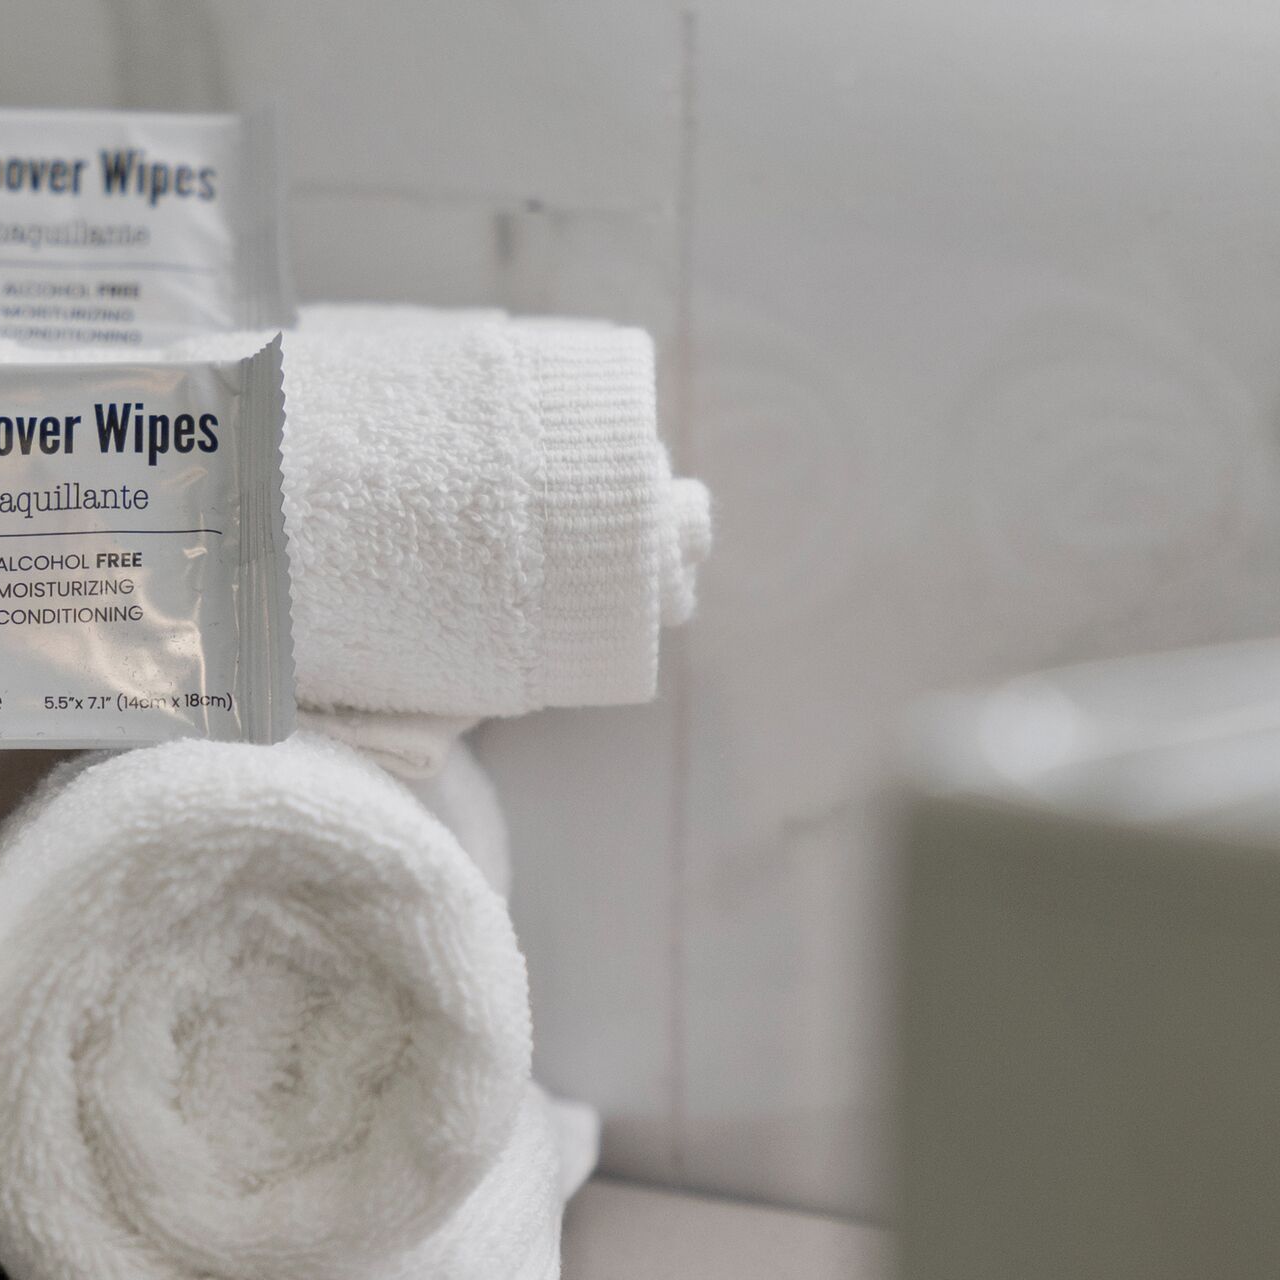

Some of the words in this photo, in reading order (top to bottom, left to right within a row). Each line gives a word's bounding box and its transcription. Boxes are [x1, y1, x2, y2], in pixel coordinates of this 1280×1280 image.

[99, 147, 217, 208] Wipes
[94, 402, 219, 466] Wipes
[96, 552, 143, 568] FREE
[116, 693, 167, 712] (14cm
[171, 697, 180, 708] x
[185, 693, 233, 711] 18cm)
